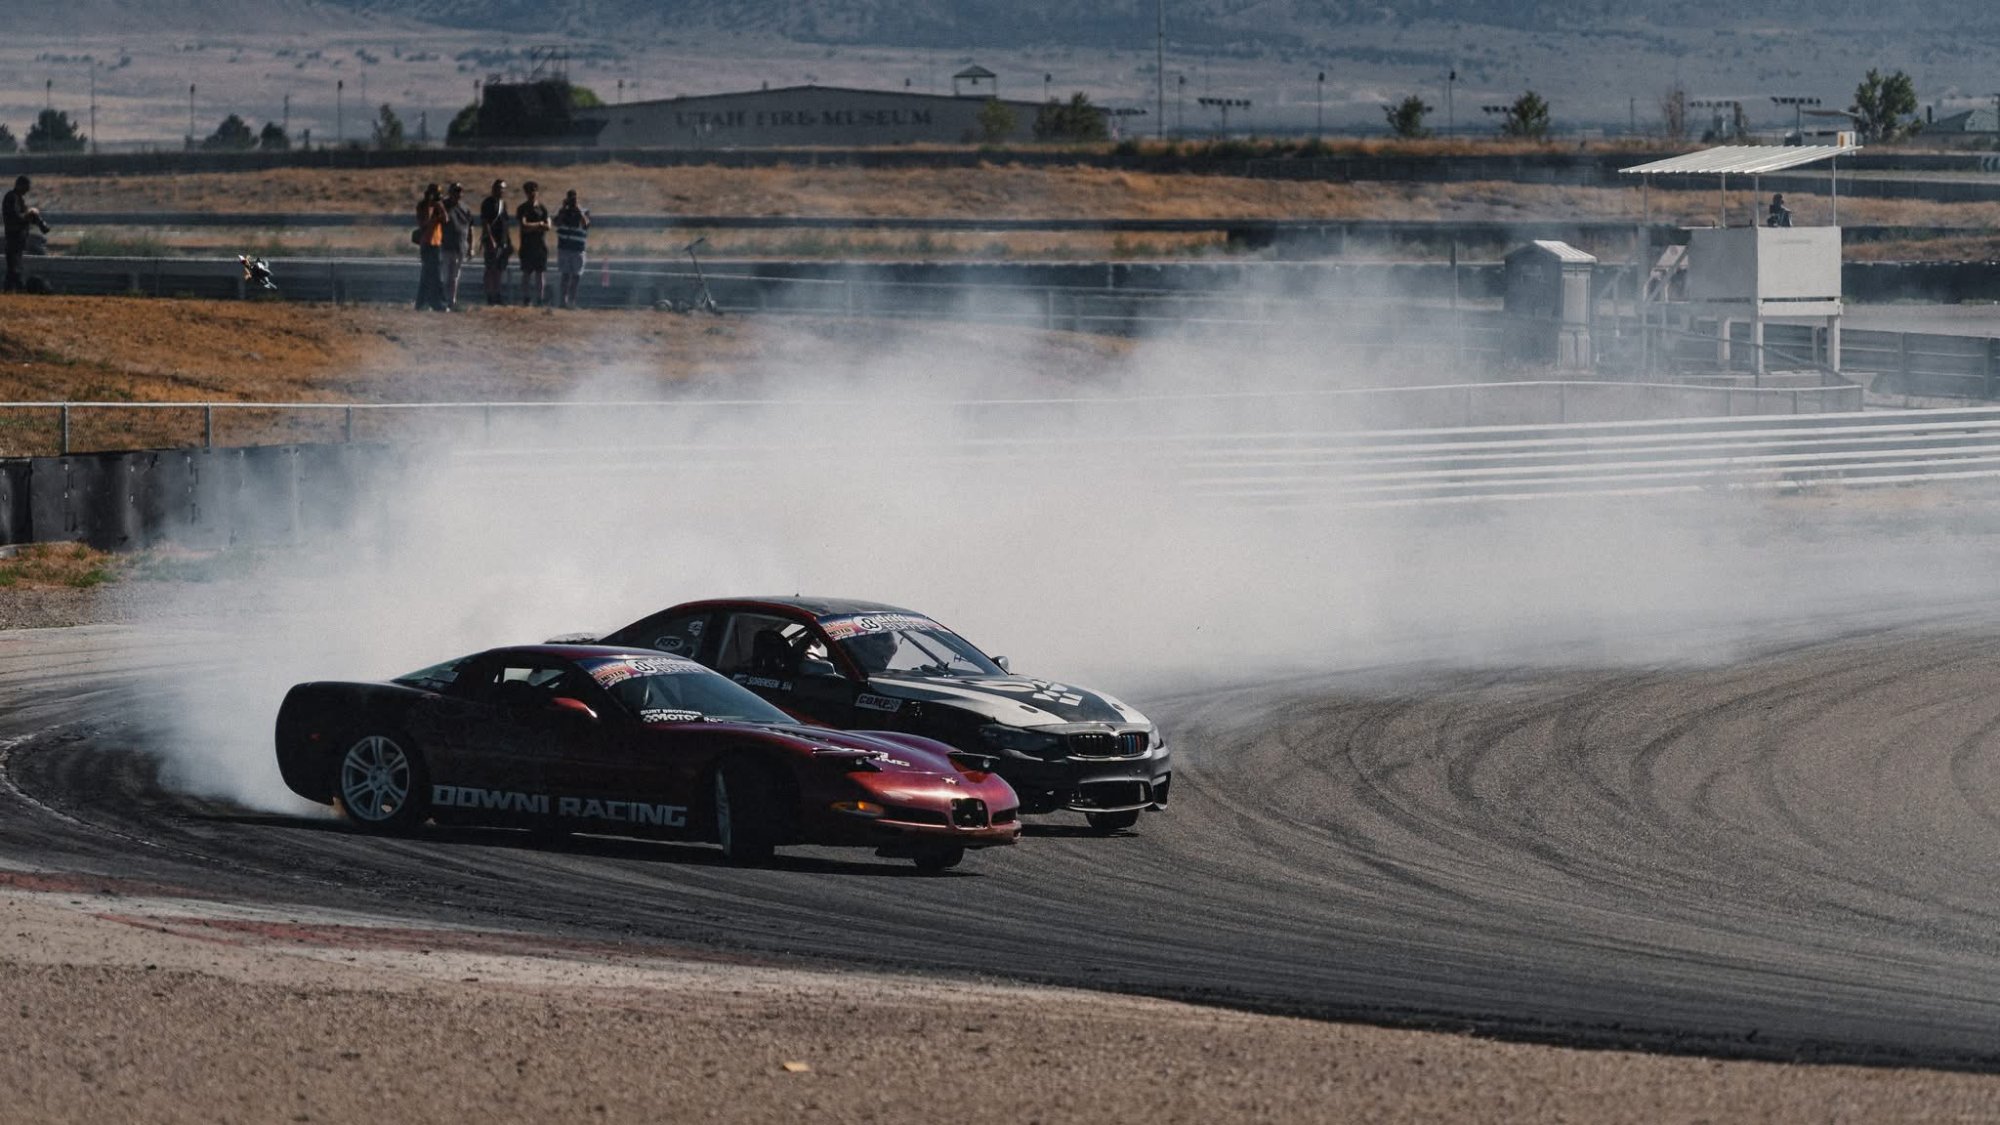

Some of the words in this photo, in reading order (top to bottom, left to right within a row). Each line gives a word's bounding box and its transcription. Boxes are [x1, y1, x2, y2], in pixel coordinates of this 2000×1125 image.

[675, 110, 746, 127] UTAH
[756, 110, 814, 126] FIRE
[821, 110, 933, 126] MUSEUM
[431, 783, 550, 814] DOWNI
[557, 796, 688, 828] RACING
